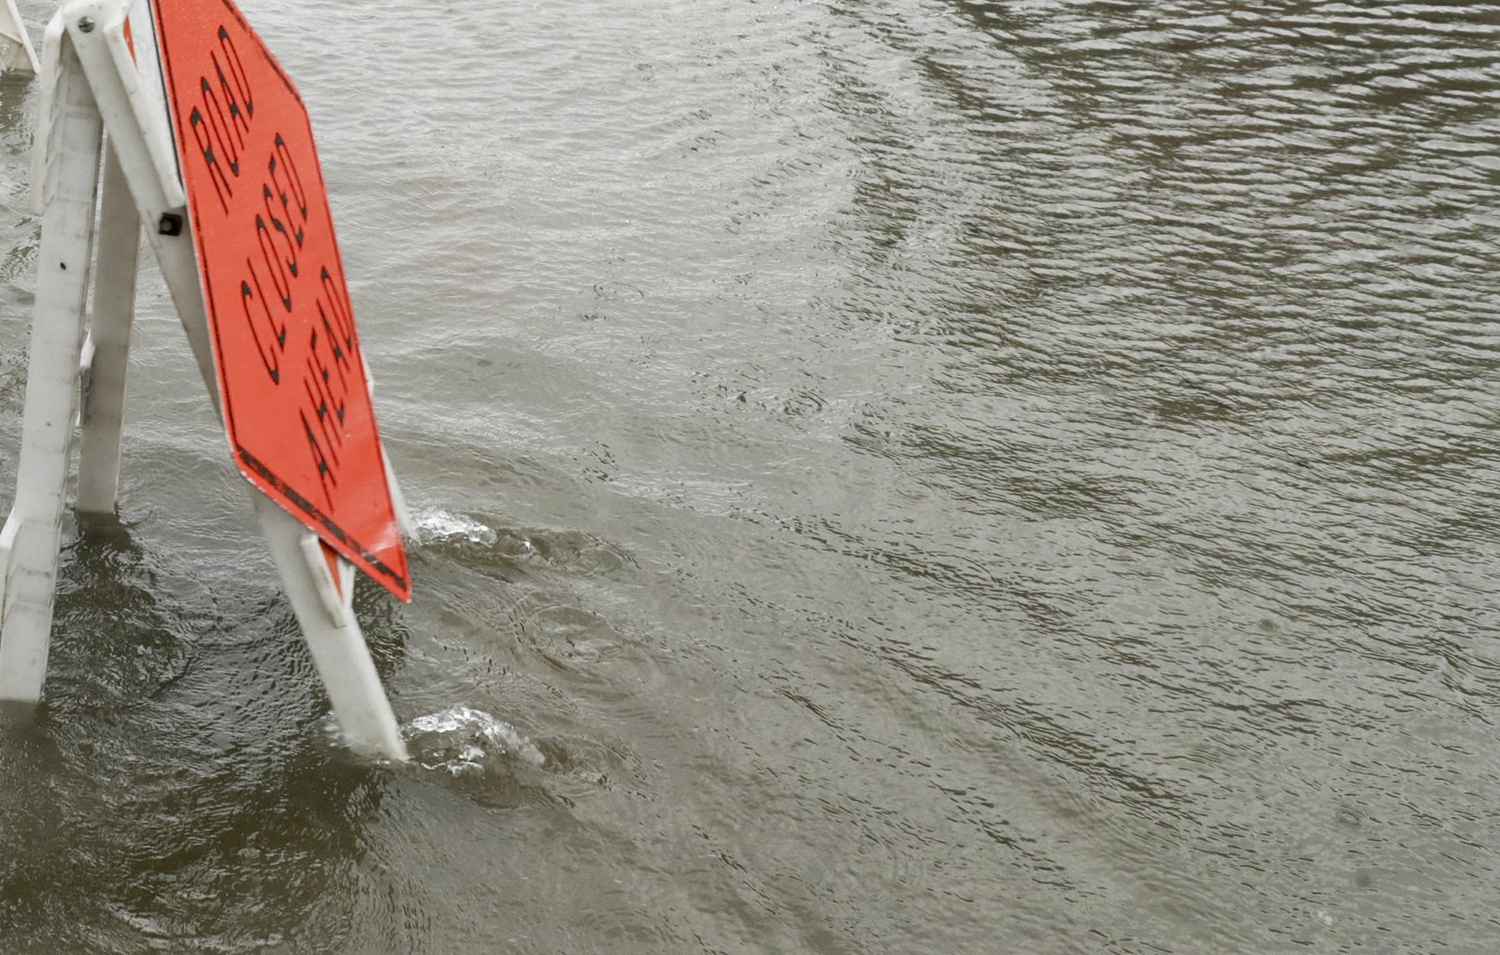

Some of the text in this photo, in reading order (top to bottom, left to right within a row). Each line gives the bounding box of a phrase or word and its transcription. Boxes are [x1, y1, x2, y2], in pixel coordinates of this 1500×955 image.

[190, 25, 253, 216] ROAD
[241, 131, 307, 386] CLOSED
[300, 265, 351, 515] AHEAD
